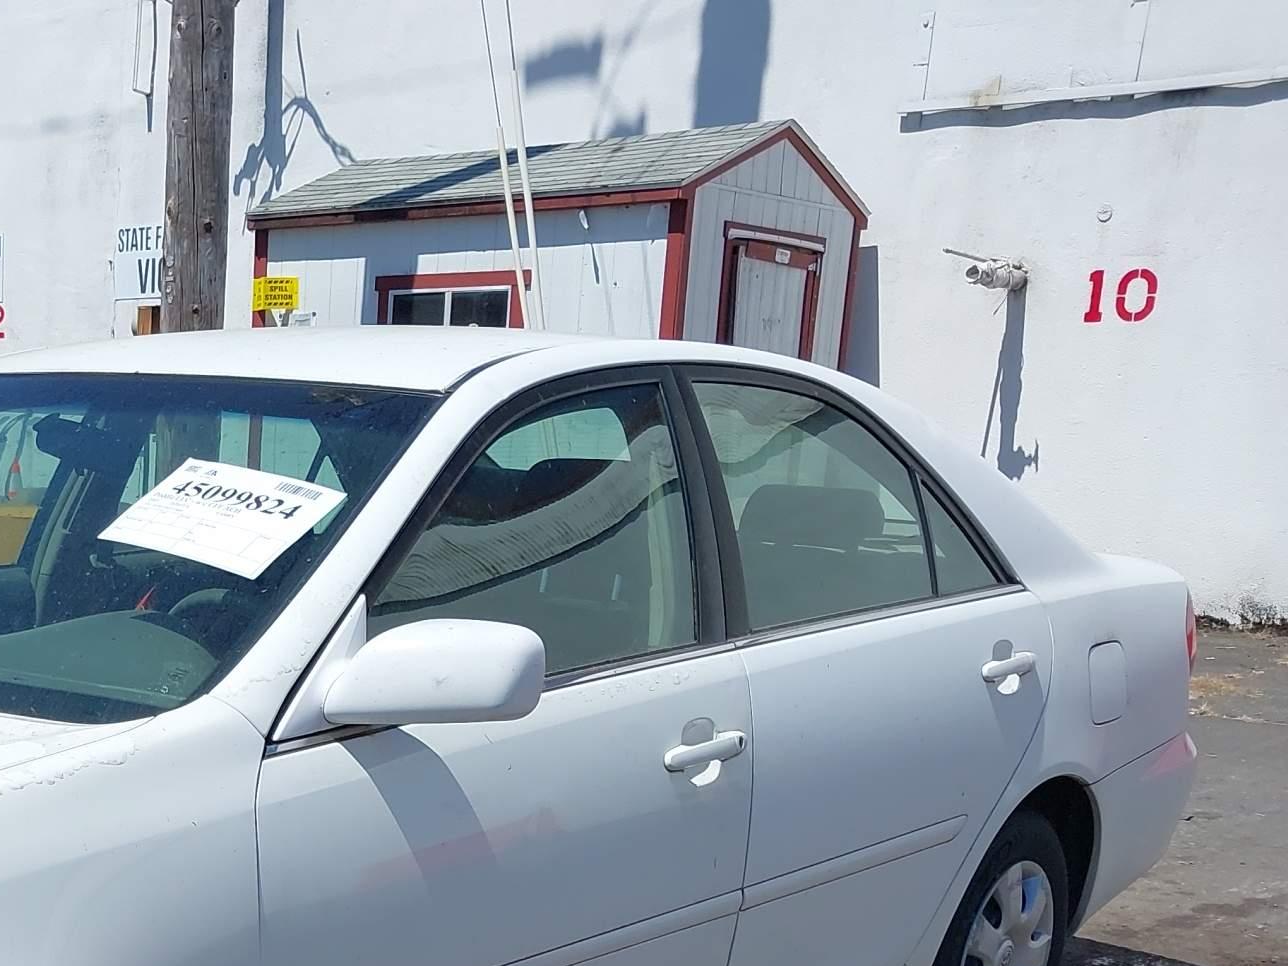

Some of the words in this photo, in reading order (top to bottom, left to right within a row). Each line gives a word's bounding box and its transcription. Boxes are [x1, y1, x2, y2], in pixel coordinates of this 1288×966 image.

[118, 226, 152, 253] STATE
[264, 293, 293, 301] STATION
[1083, 268, 1158, 323] 10
[172, 480, 302, 519] 45099824
